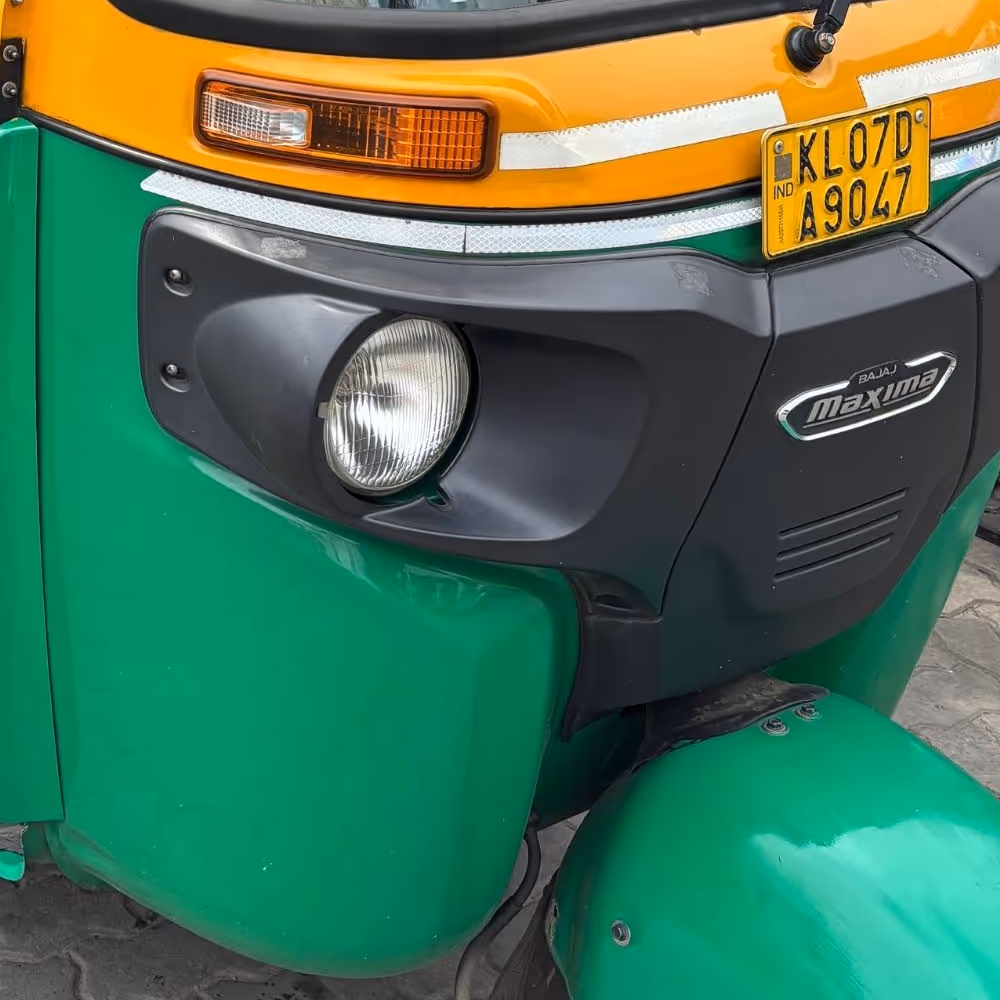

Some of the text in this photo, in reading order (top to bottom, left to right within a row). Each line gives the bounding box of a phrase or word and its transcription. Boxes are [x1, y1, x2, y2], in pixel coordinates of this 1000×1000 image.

[799, 109, 913, 185] KL07D
[773, 182, 794, 200] IND
[799, 164, 912, 242] A9047
[858, 364, 898, 385] BAJAJ
